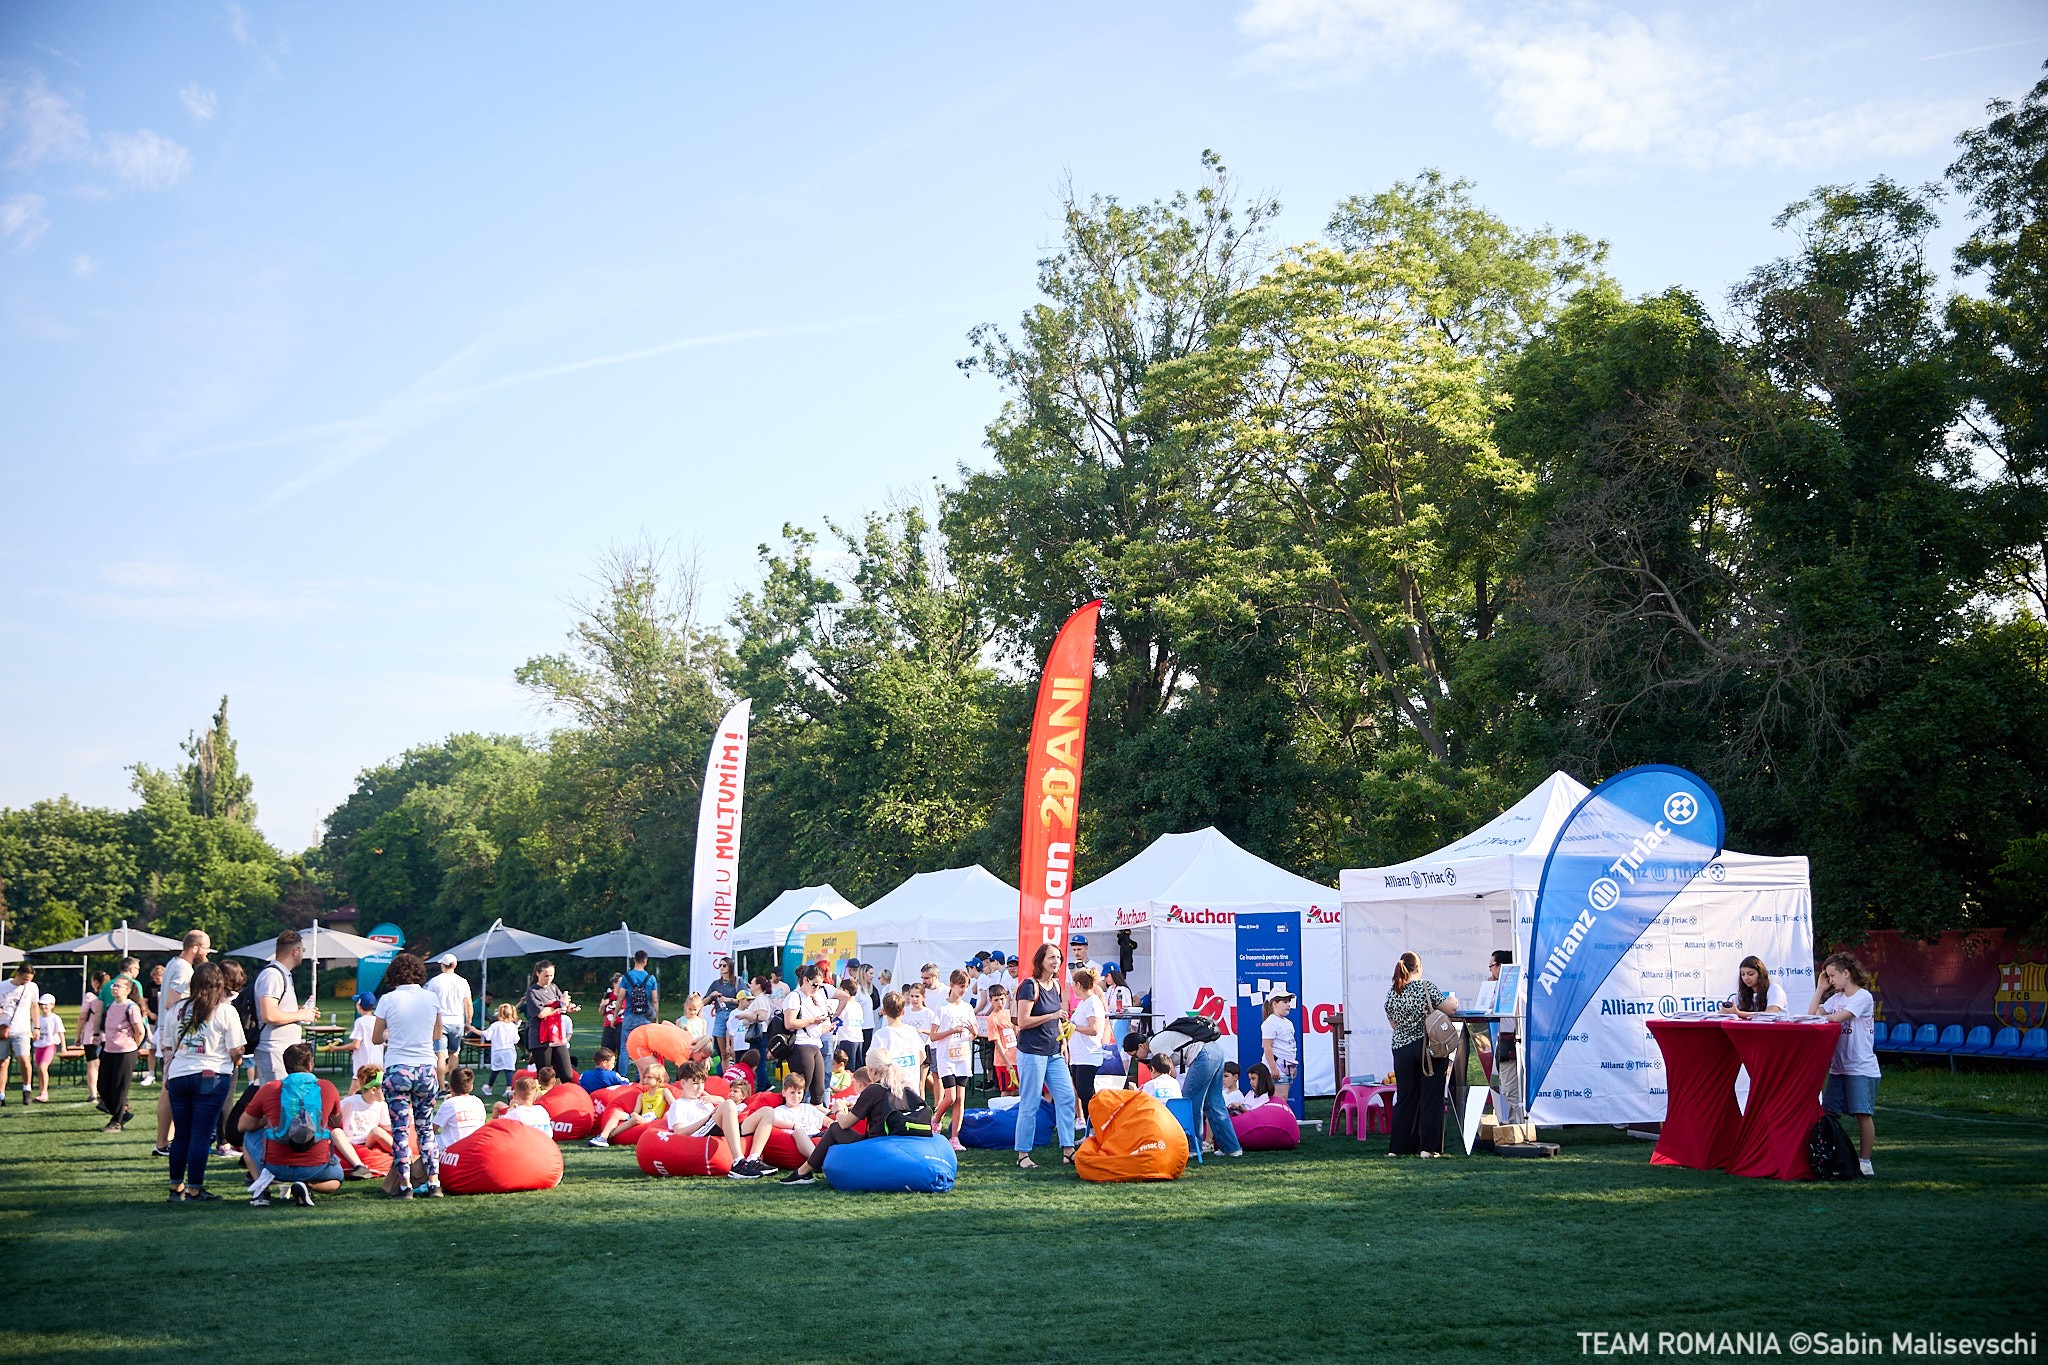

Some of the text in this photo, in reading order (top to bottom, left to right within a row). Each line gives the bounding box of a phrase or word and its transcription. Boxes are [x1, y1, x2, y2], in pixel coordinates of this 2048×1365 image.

[1384, 875, 1411, 888] Allianz
[1040, 842, 1070, 951] chan
[1069, 913, 1093, 929] uchan
[1115, 907, 1146, 926] Auchan
[1167, 905, 1237, 924] Auchan
[1537, 909, 1597, 995] Allianz
[1641, 971, 1664, 979] Allianz
[1601, 999, 1654, 1015] Allianz
[1600, 1061, 1624, 1069] Allianz
